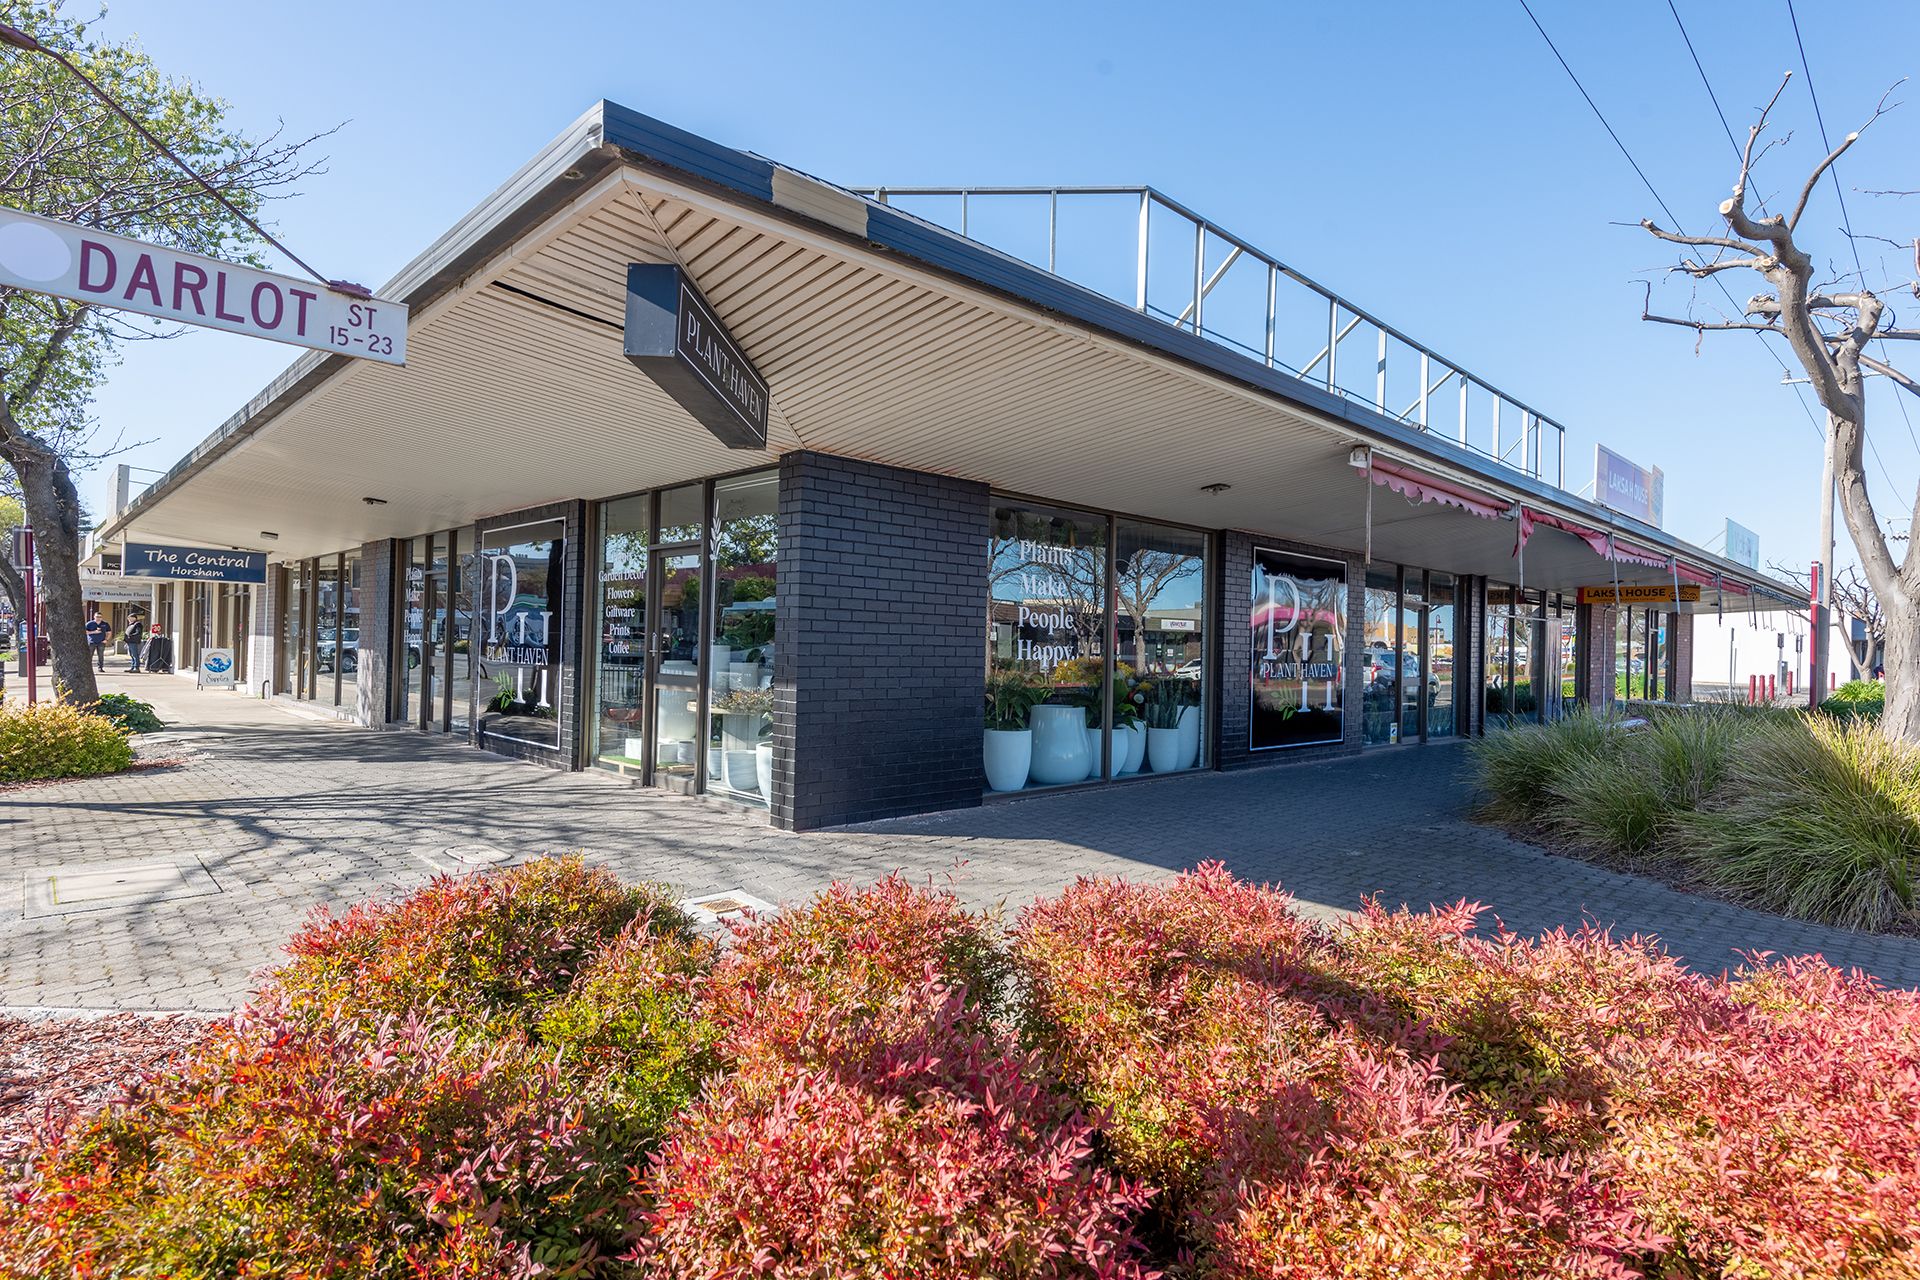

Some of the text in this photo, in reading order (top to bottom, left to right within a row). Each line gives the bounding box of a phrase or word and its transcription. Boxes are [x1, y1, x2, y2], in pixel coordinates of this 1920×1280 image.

[78, 239, 317, 337] DARLOT
[347, 303, 378, 331] ST
[329, 325, 393, 356] 15-23
[686, 310, 763, 422] PLANT HAVEN
[144, 550, 251, 568] The Central
[1019, 539, 1073, 566] Plants
[170, 566, 225, 577] Horsham
[598, 571, 623, 582] Garden
[607, 588, 635, 599] Flowers
[1019, 573, 1067, 597] Make
[1586, 588, 1666, 598] LAKSA HOUSE
[605, 605, 636, 618] Giftware
[1017, 606, 1074, 635] People
[609, 624, 631, 636] Prints
[487, 645, 549, 666] PLANT HAVEN
[608, 641, 630, 654] Coffee
[1016, 639, 1076, 668] Happy.
[1263, 662, 1333, 679] PLANT HAVEN
